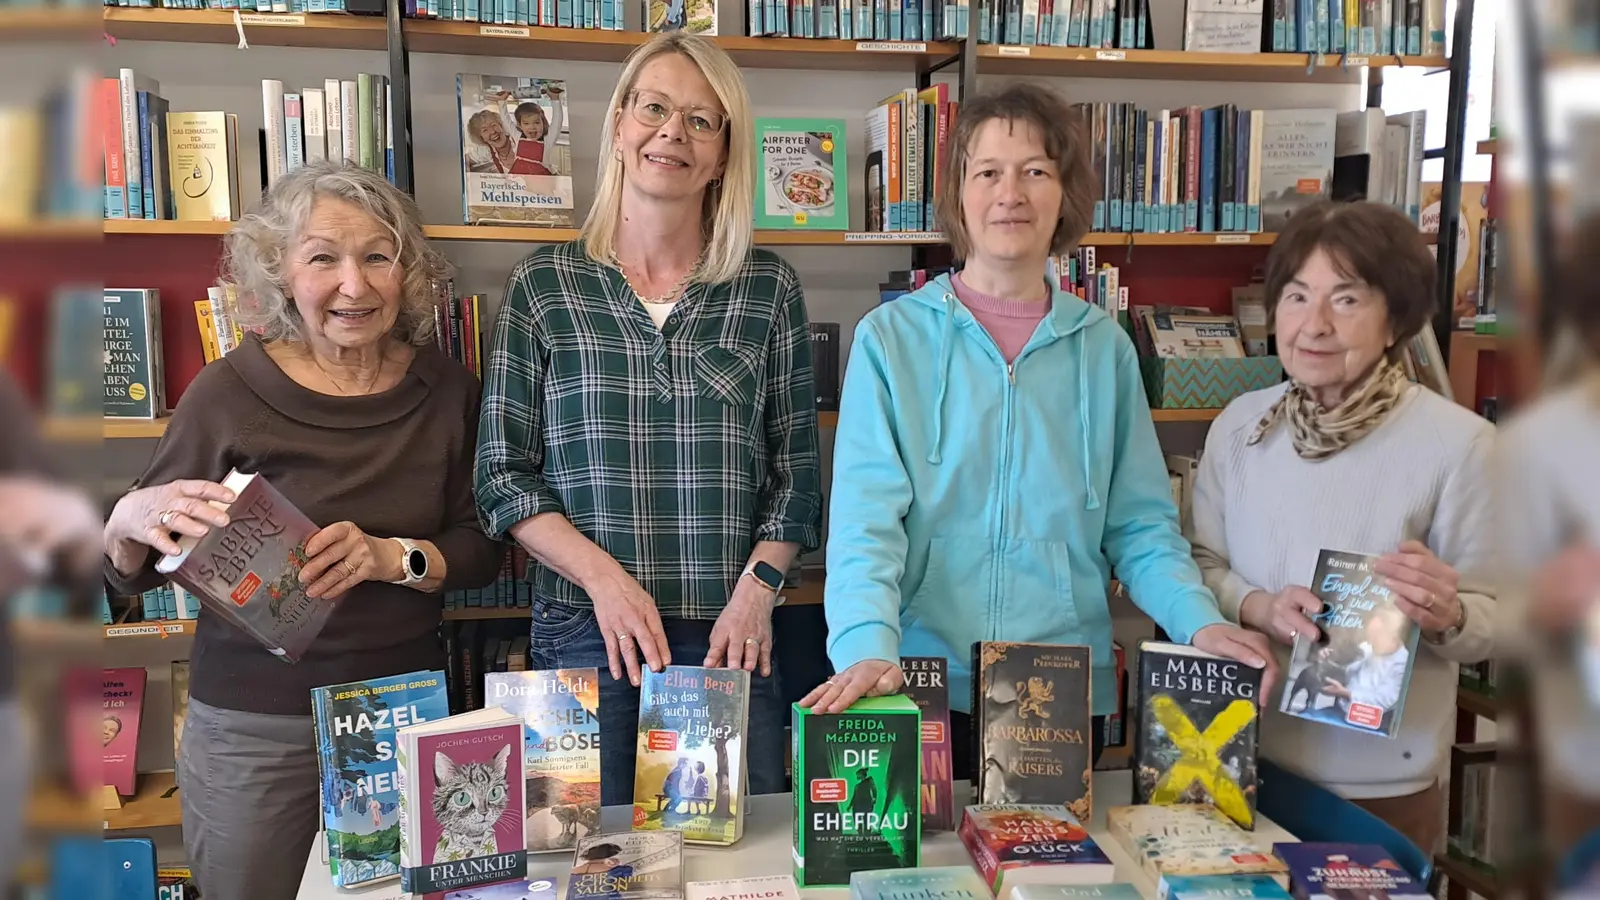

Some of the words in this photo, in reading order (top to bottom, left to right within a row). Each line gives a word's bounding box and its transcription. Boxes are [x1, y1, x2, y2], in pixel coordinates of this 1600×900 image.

[861, 42, 921, 50] GESCHICHTE
[290, 124, 298, 152] sterben
[762, 136, 810, 144] AIRFRYER
[762, 146, 782, 154] FOR
[908, 134, 916, 162] GEMACHT
[908, 164, 916, 188] LEICHT
[480, 181, 526, 191] Bayerische
[481, 190, 562, 206] Mehlspeisen
[116, 318, 130, 327] IM
[104, 341, 132, 350] IRGE
[113, 352, 141, 362] MAN
[104, 364, 136, 374] EHEN
[104, 387, 126, 396] USS
[197, 494, 275, 584] SABINE
[218, 511, 287, 588] EBERT
[1322, 574, 1372, 599] Engel
[1167, 658, 1238, 680] MARC
[334, 688, 370, 700] JESSICA
[372, 682, 406, 696] BERGER
[408, 678, 437, 690] GROSS
[495, 681, 534, 698] Dora
[544, 677, 590, 695] Heldt
[664, 670, 698, 688] Ellen
[704, 676, 736, 694] Berg
[1150, 672, 1254, 698] ELSBERG
[680, 690, 698, 702] das
[334, 704, 426, 736] HAZEL
[541, 708, 600, 726] CHEN
[664, 705, 688, 717] auch
[693, 704, 710, 718] mit
[686, 718, 732, 739] Liebe?
[838, 720, 884, 730] FREIDA
[436, 738, 468, 748] JOCHEN
[472, 734, 504, 744] GUTSCH
[546, 729, 600, 752] BÖSE
[826, 732, 896, 742] McFADDEN
[988, 725, 1083, 744] BARBAROSSA
[527, 756, 542, 764] Karl
[844, 750, 880, 768] DIE
[922, 784, 936, 814] N
[973, 804, 1025, 813] LOUISE
[813, 812, 908, 832] EHEFRAU
[1020, 834, 1058, 842] ZEIT
[430, 854, 517, 882] FRANKIE
[435, 877, 464, 888] UNTER
[466, 870, 512, 885] MENSCHEN
[1060, 887, 1103, 897] Und
